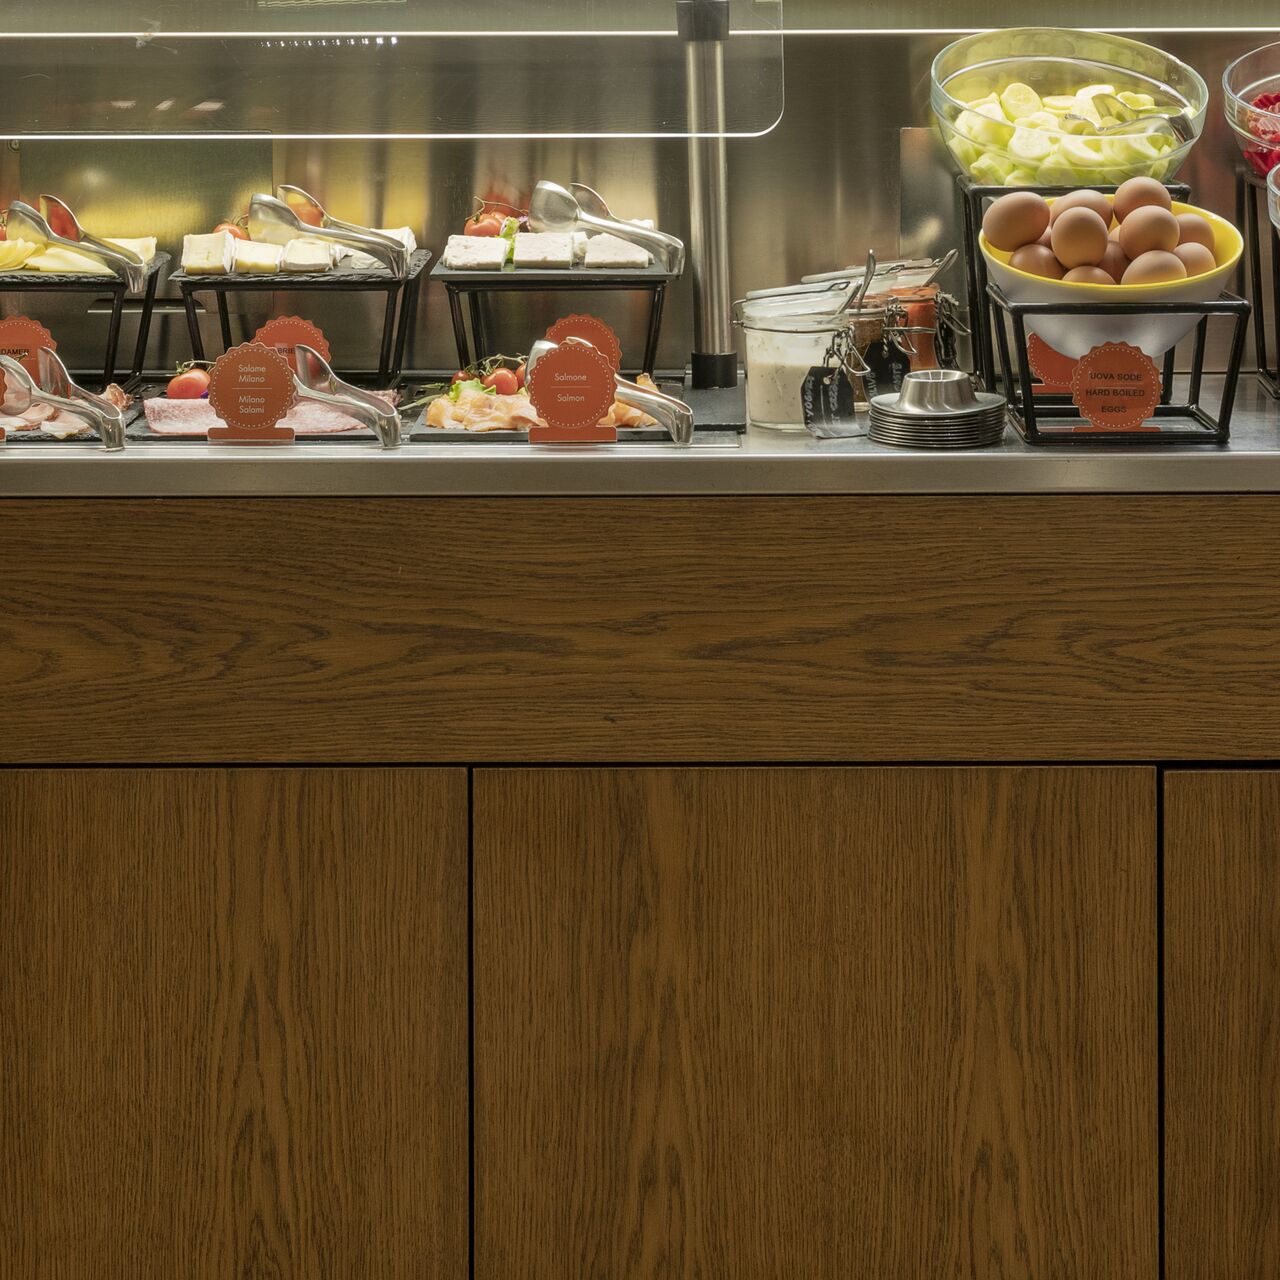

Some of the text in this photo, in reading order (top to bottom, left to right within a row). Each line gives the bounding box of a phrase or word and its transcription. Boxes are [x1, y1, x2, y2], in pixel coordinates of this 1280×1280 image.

[238, 364, 266, 373] Salame
[238, 374, 265, 383] Milano
[554, 372, 587, 381] Salmone
[1117, 373, 1142, 381] SODE
[1085, 388, 1145, 397] HARD BOILED
[238, 395, 265, 403] Milano
[557, 394, 585, 402] Salmon
[239, 405, 265, 414] Salami
